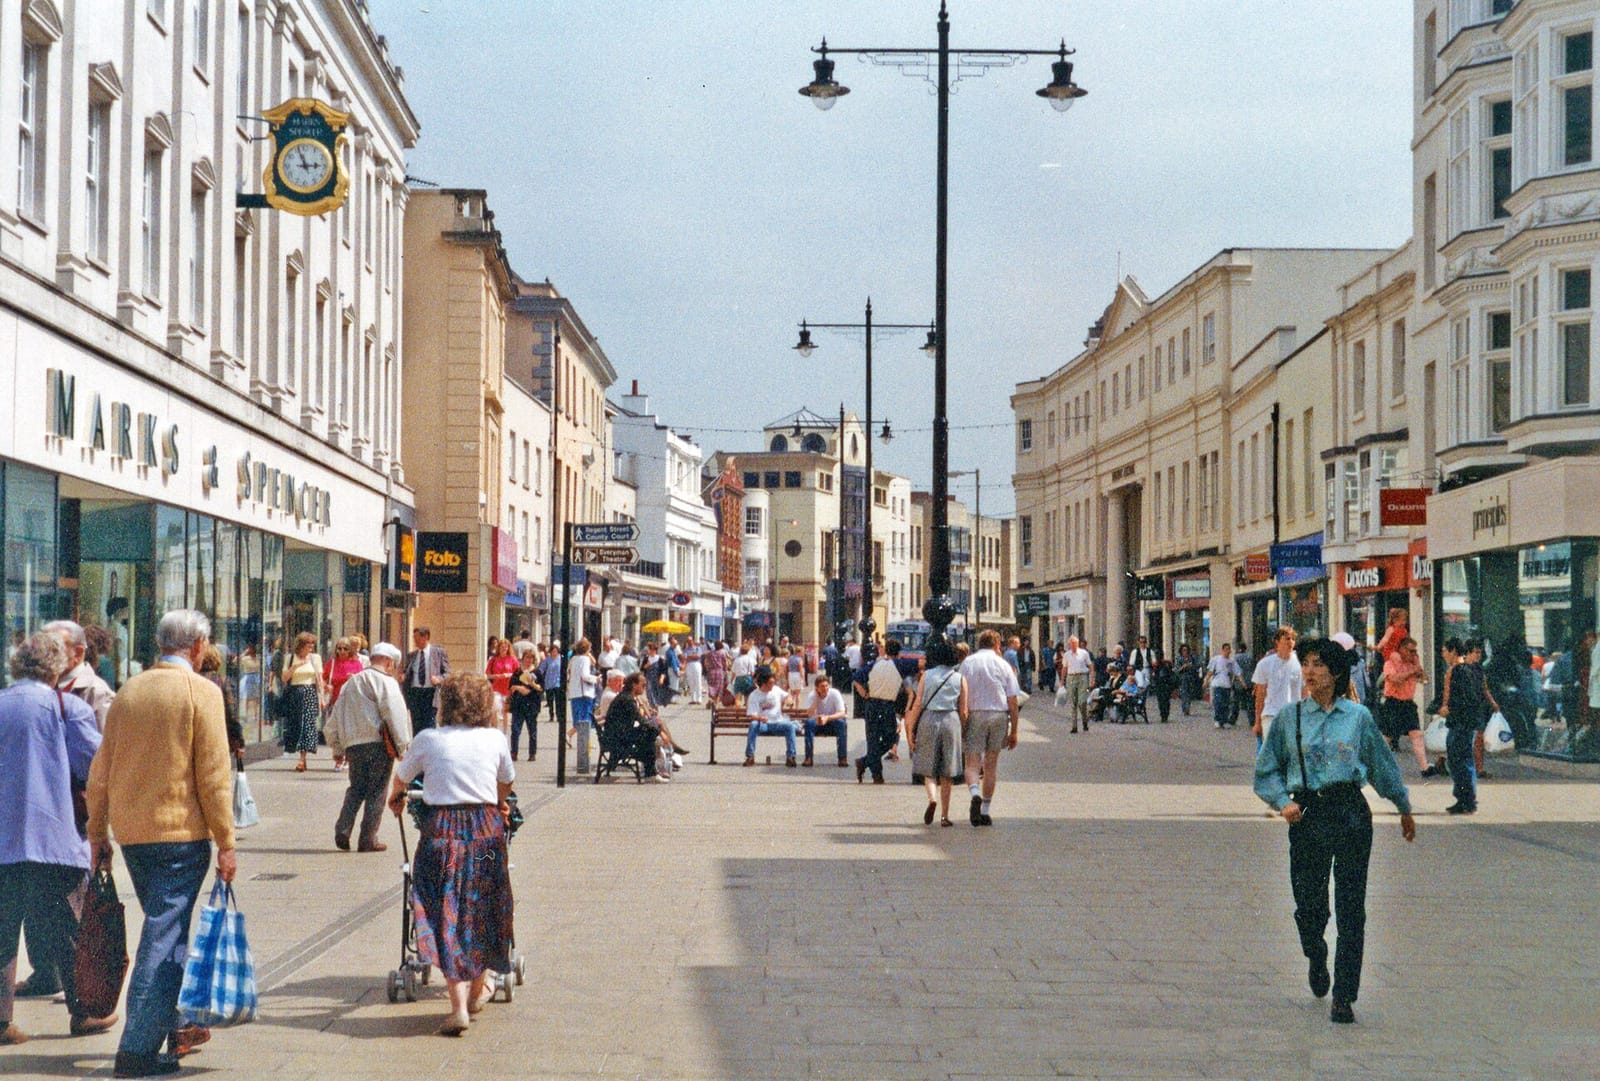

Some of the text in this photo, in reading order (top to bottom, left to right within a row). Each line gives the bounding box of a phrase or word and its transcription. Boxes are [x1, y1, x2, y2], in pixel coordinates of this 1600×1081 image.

[46, 368, 331, 527] MARKS & SPENCER
[1345, 566, 1380, 590] Dixons
